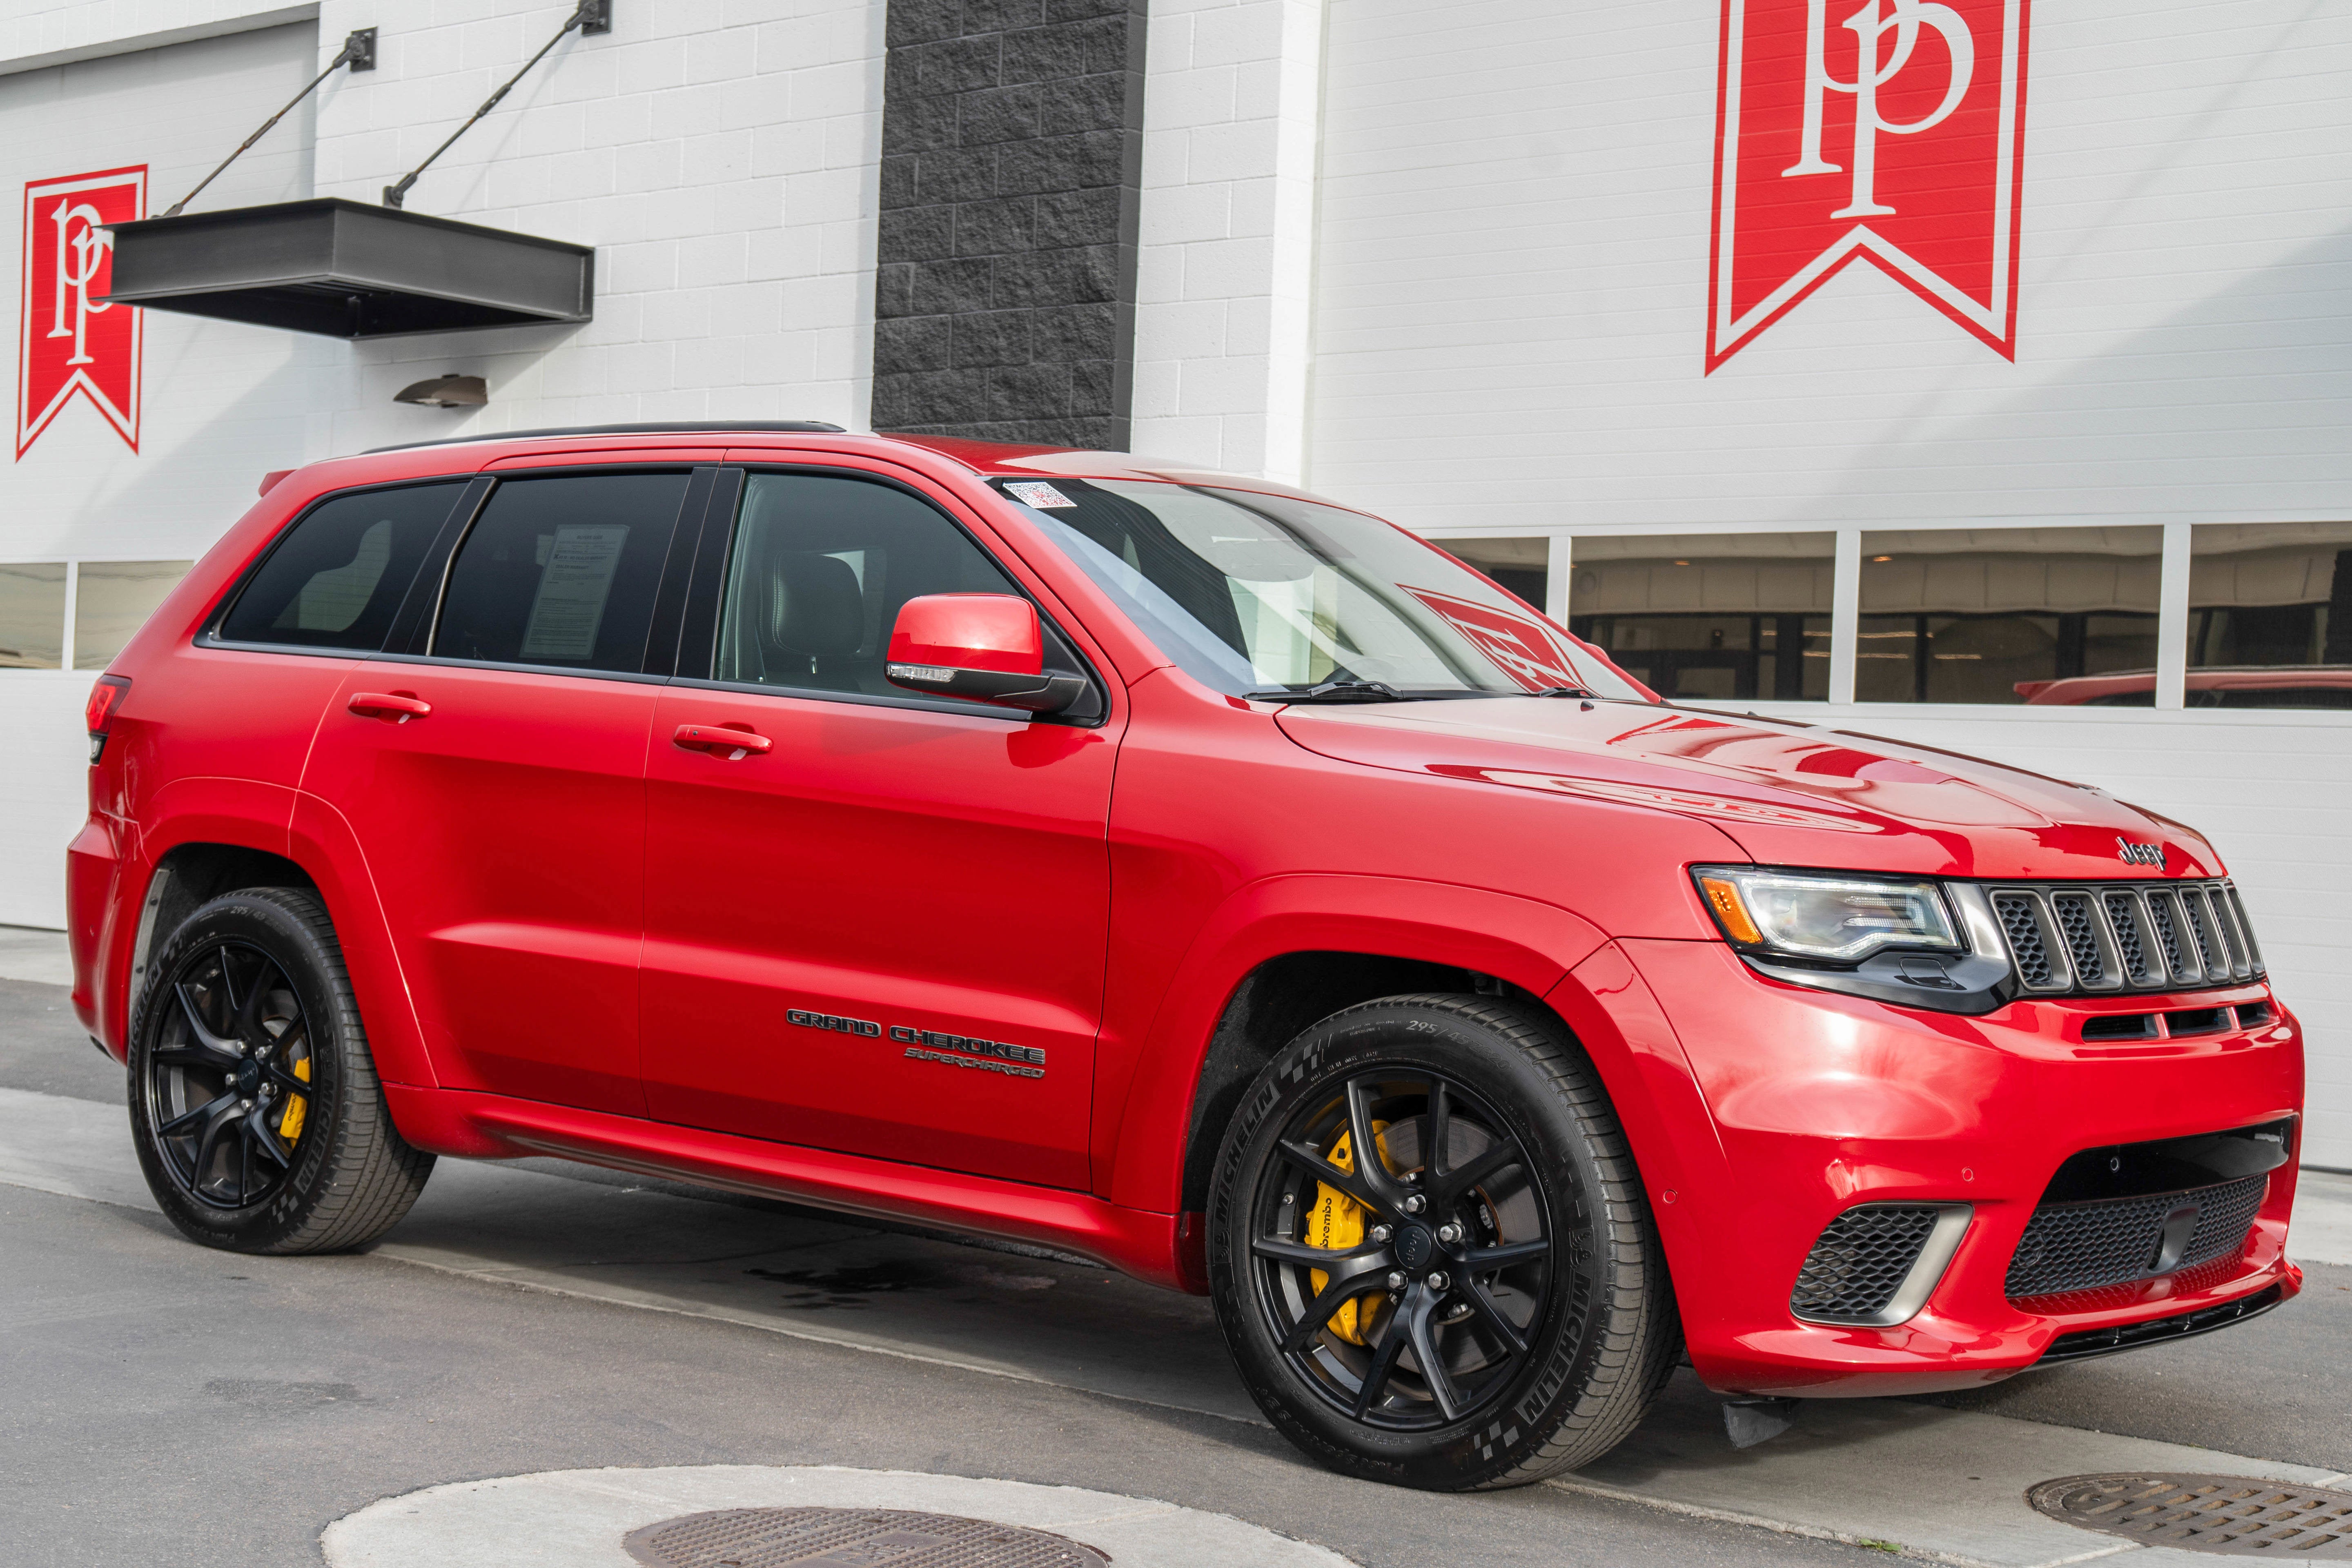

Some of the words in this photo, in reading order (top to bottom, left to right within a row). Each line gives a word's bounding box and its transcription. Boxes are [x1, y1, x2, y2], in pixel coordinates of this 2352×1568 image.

[2116, 836, 2167, 871] Jeep
[786, 1008, 881, 1038] GRAND
[889, 1025, 1045, 1065] CHEROKEE
[904, 1047, 1045, 1078] SUPERCHARGED
[288, 1094, 297, 1121] rembo
[298, 1078, 334, 1192] MICHELIN
[1215, 1080, 1274, 1226] MICHELIN
[1320, 1197, 1332, 1248] brembo
[1405, 1230, 1421, 1262] Jeep
[1523, 1272, 1592, 1422] MICHELIN
